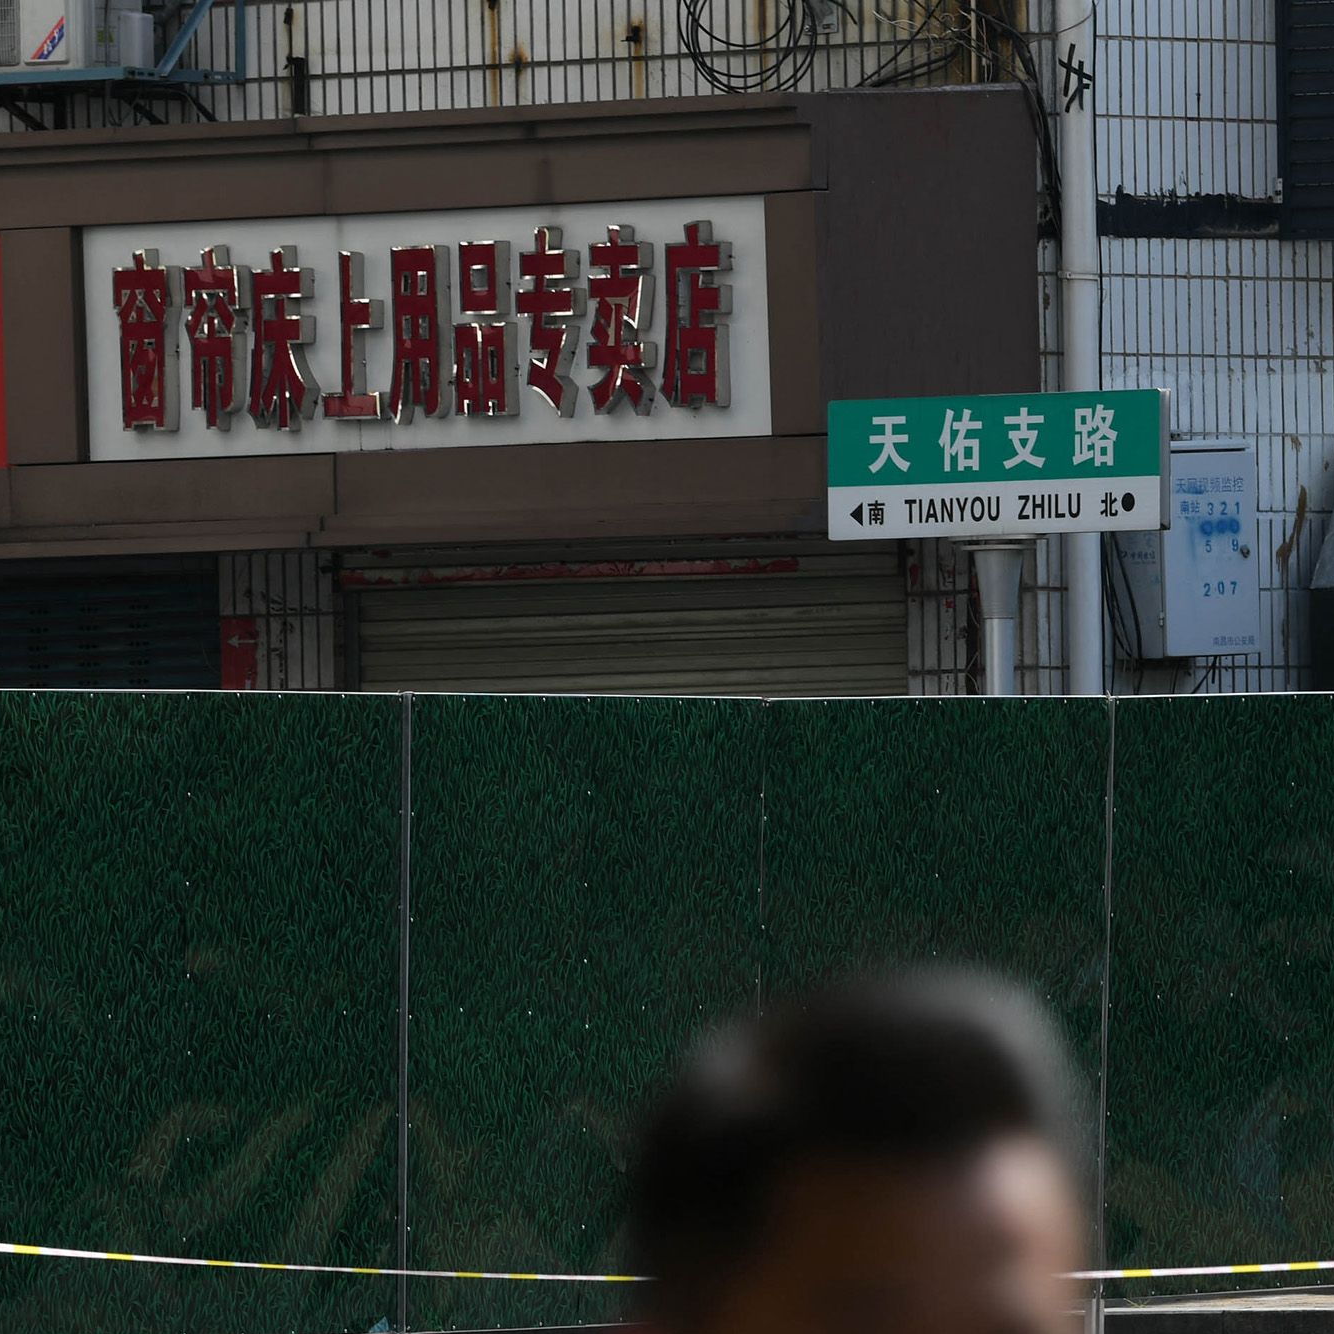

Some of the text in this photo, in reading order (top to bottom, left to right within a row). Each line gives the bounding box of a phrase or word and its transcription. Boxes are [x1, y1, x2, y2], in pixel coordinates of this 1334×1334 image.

[112, 220, 733, 432] 窗帘床上用品专卖店
[868, 403, 1118, 474] 天佑支路
[867, 490, 1119, 527] 南 TIANYOU ZHILU 北
